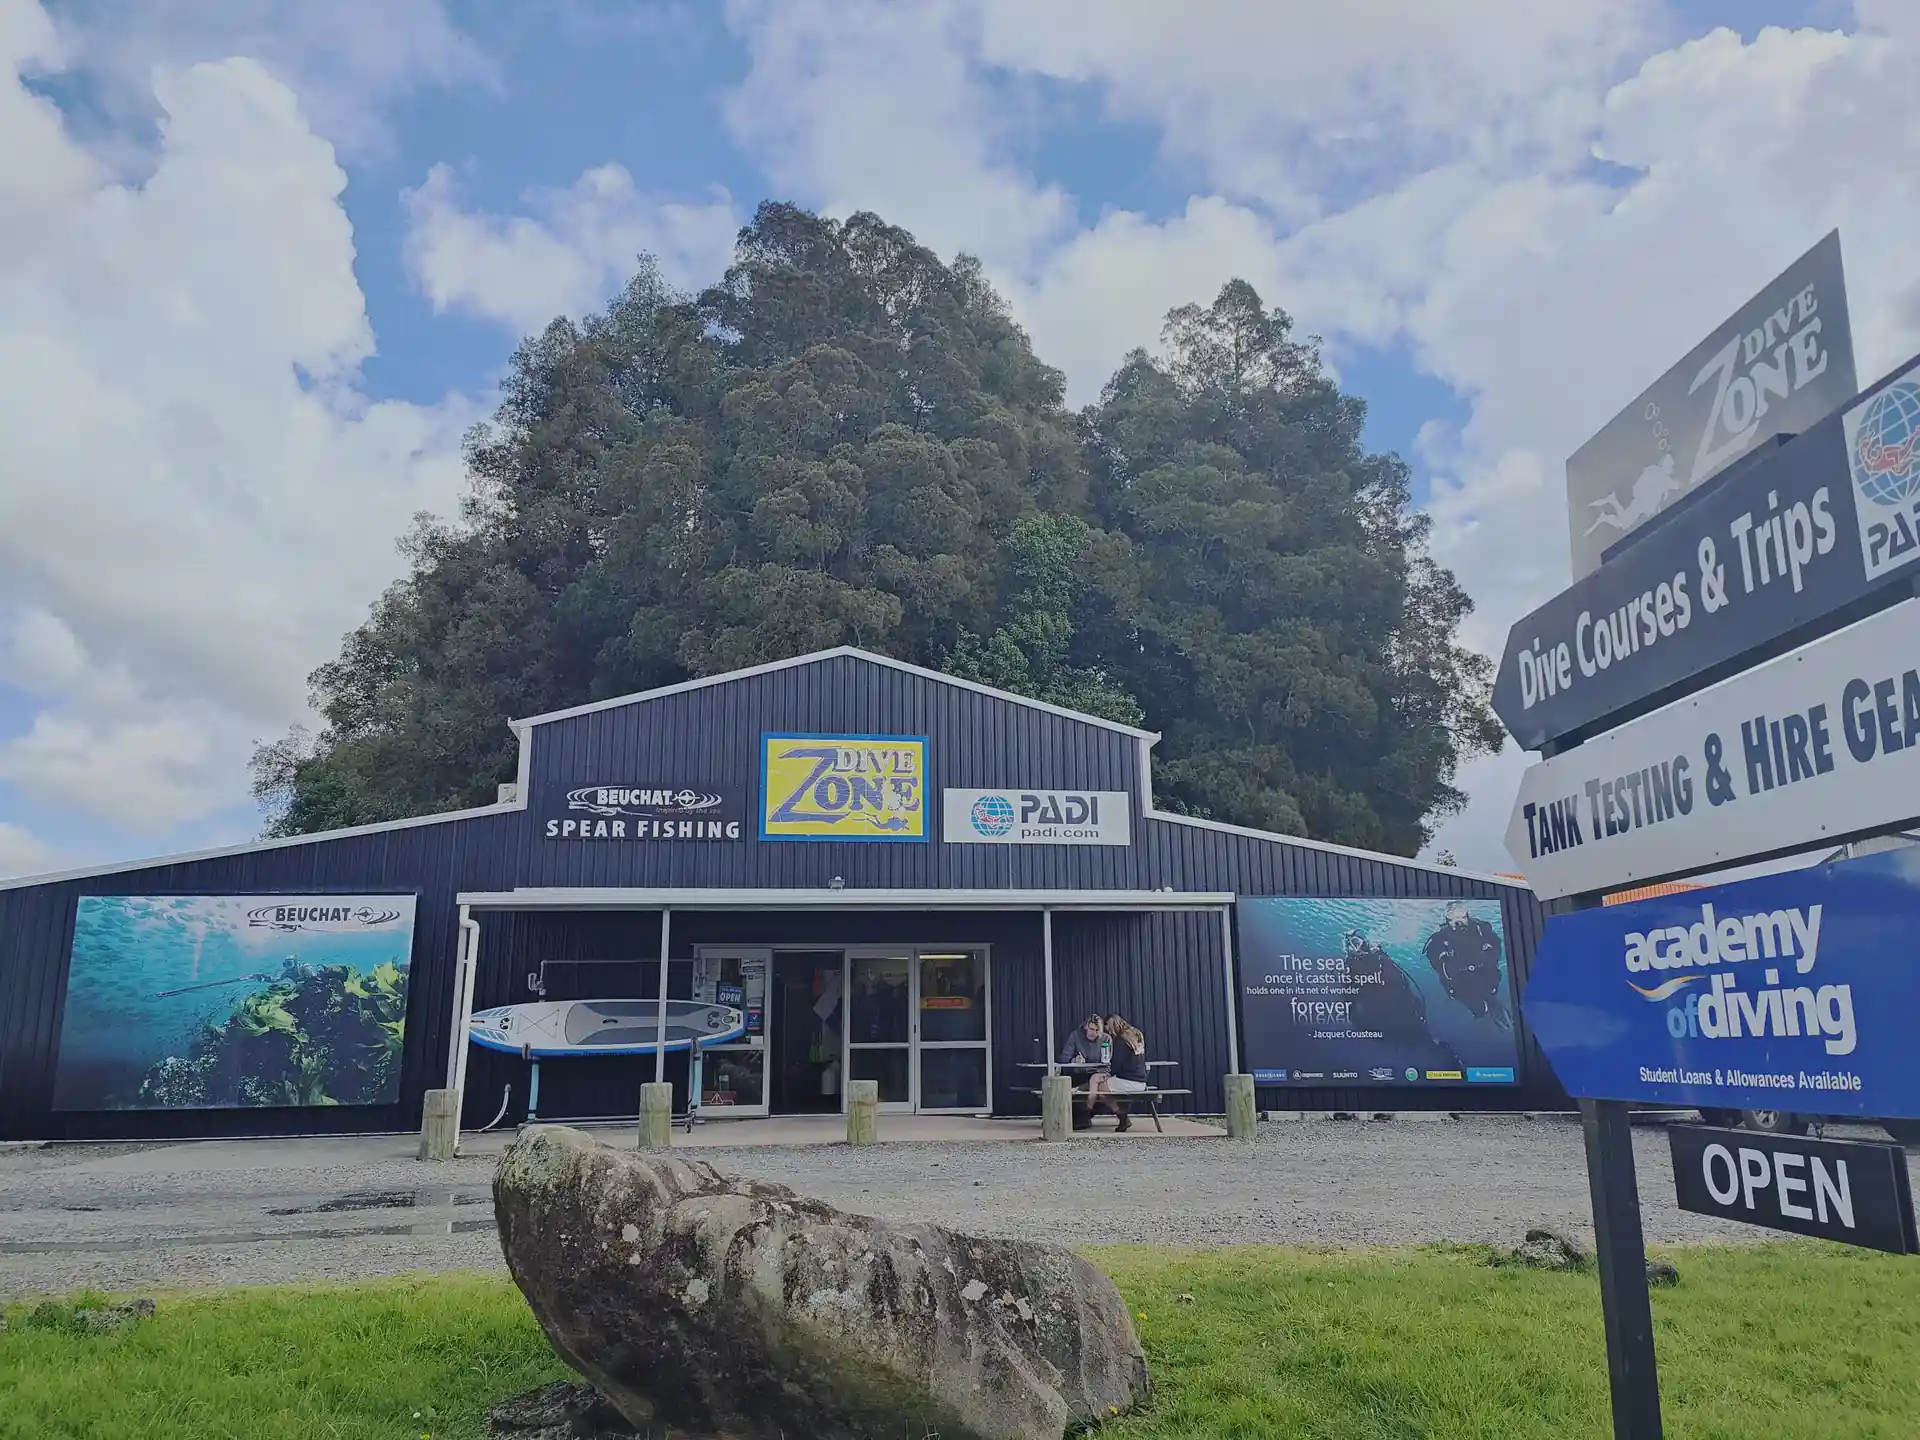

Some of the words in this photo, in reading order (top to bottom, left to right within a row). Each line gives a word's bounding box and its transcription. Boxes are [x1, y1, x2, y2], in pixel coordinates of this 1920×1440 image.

[1743, 283, 1819, 364] DIVE
[1688, 317, 1828, 484] ZONE
[1866, 503, 1920, 568] PA
[1518, 637, 1572, 710] Dive
[1576, 570, 1692, 678] Courses
[1697, 536, 1729, 613] &
[1730, 486, 1836, 593] Trips
[835, 747, 916, 774] DIVE
[767, 745, 920, 825] ZONE
[1523, 795, 1584, 859] TANK
[1585, 754, 1694, 840] TESTING
[1704, 733, 1737, 806] &
[1741, 703, 1835, 795] HIRE
[1020, 795, 1099, 825] PADI
[546, 819, 625, 838] SPEAR
[637, 820, 740, 839] FISHING
[1021, 826, 1100, 840] padi.com
[274, 906, 351, 922] BEUCHAT
[1624, 902, 1823, 974] academy
[1280, 954, 1312, 971] The
[1316, 957, 1351, 973] sea,
[1246, 986, 1269, 995] holds
[1286, 987, 1294, 995] in
[1295, 987, 1305, 995] its
[1306, 987, 1319, 995] net
[1320, 986, 1329, 995] of
[1329, 986, 1360, 995] wonder
[1264, 974, 1293, 984] once
[1295, 972, 1304, 984] it
[1306, 973, 1336, 984] casts
[1337, 972, 1352, 984] its
[1353, 971, 1386, 986] spell,
[719, 991, 741, 1003] OPEN
[1290, 996, 1353, 1014] forever
[1312, 1029, 1345, 1040] Jacques
[1345, 1029, 1383, 1038] Cousteau
[1639, 1066, 1679, 1084] Student
[1680, 1068, 1713, 1086] Loans
[1715, 1069, 1725, 1086] &
[1726, 1068, 1795, 1089] Allowances
[1798, 1070, 1862, 1091] Available
[1702, 1143, 1856, 1229] OPEN
